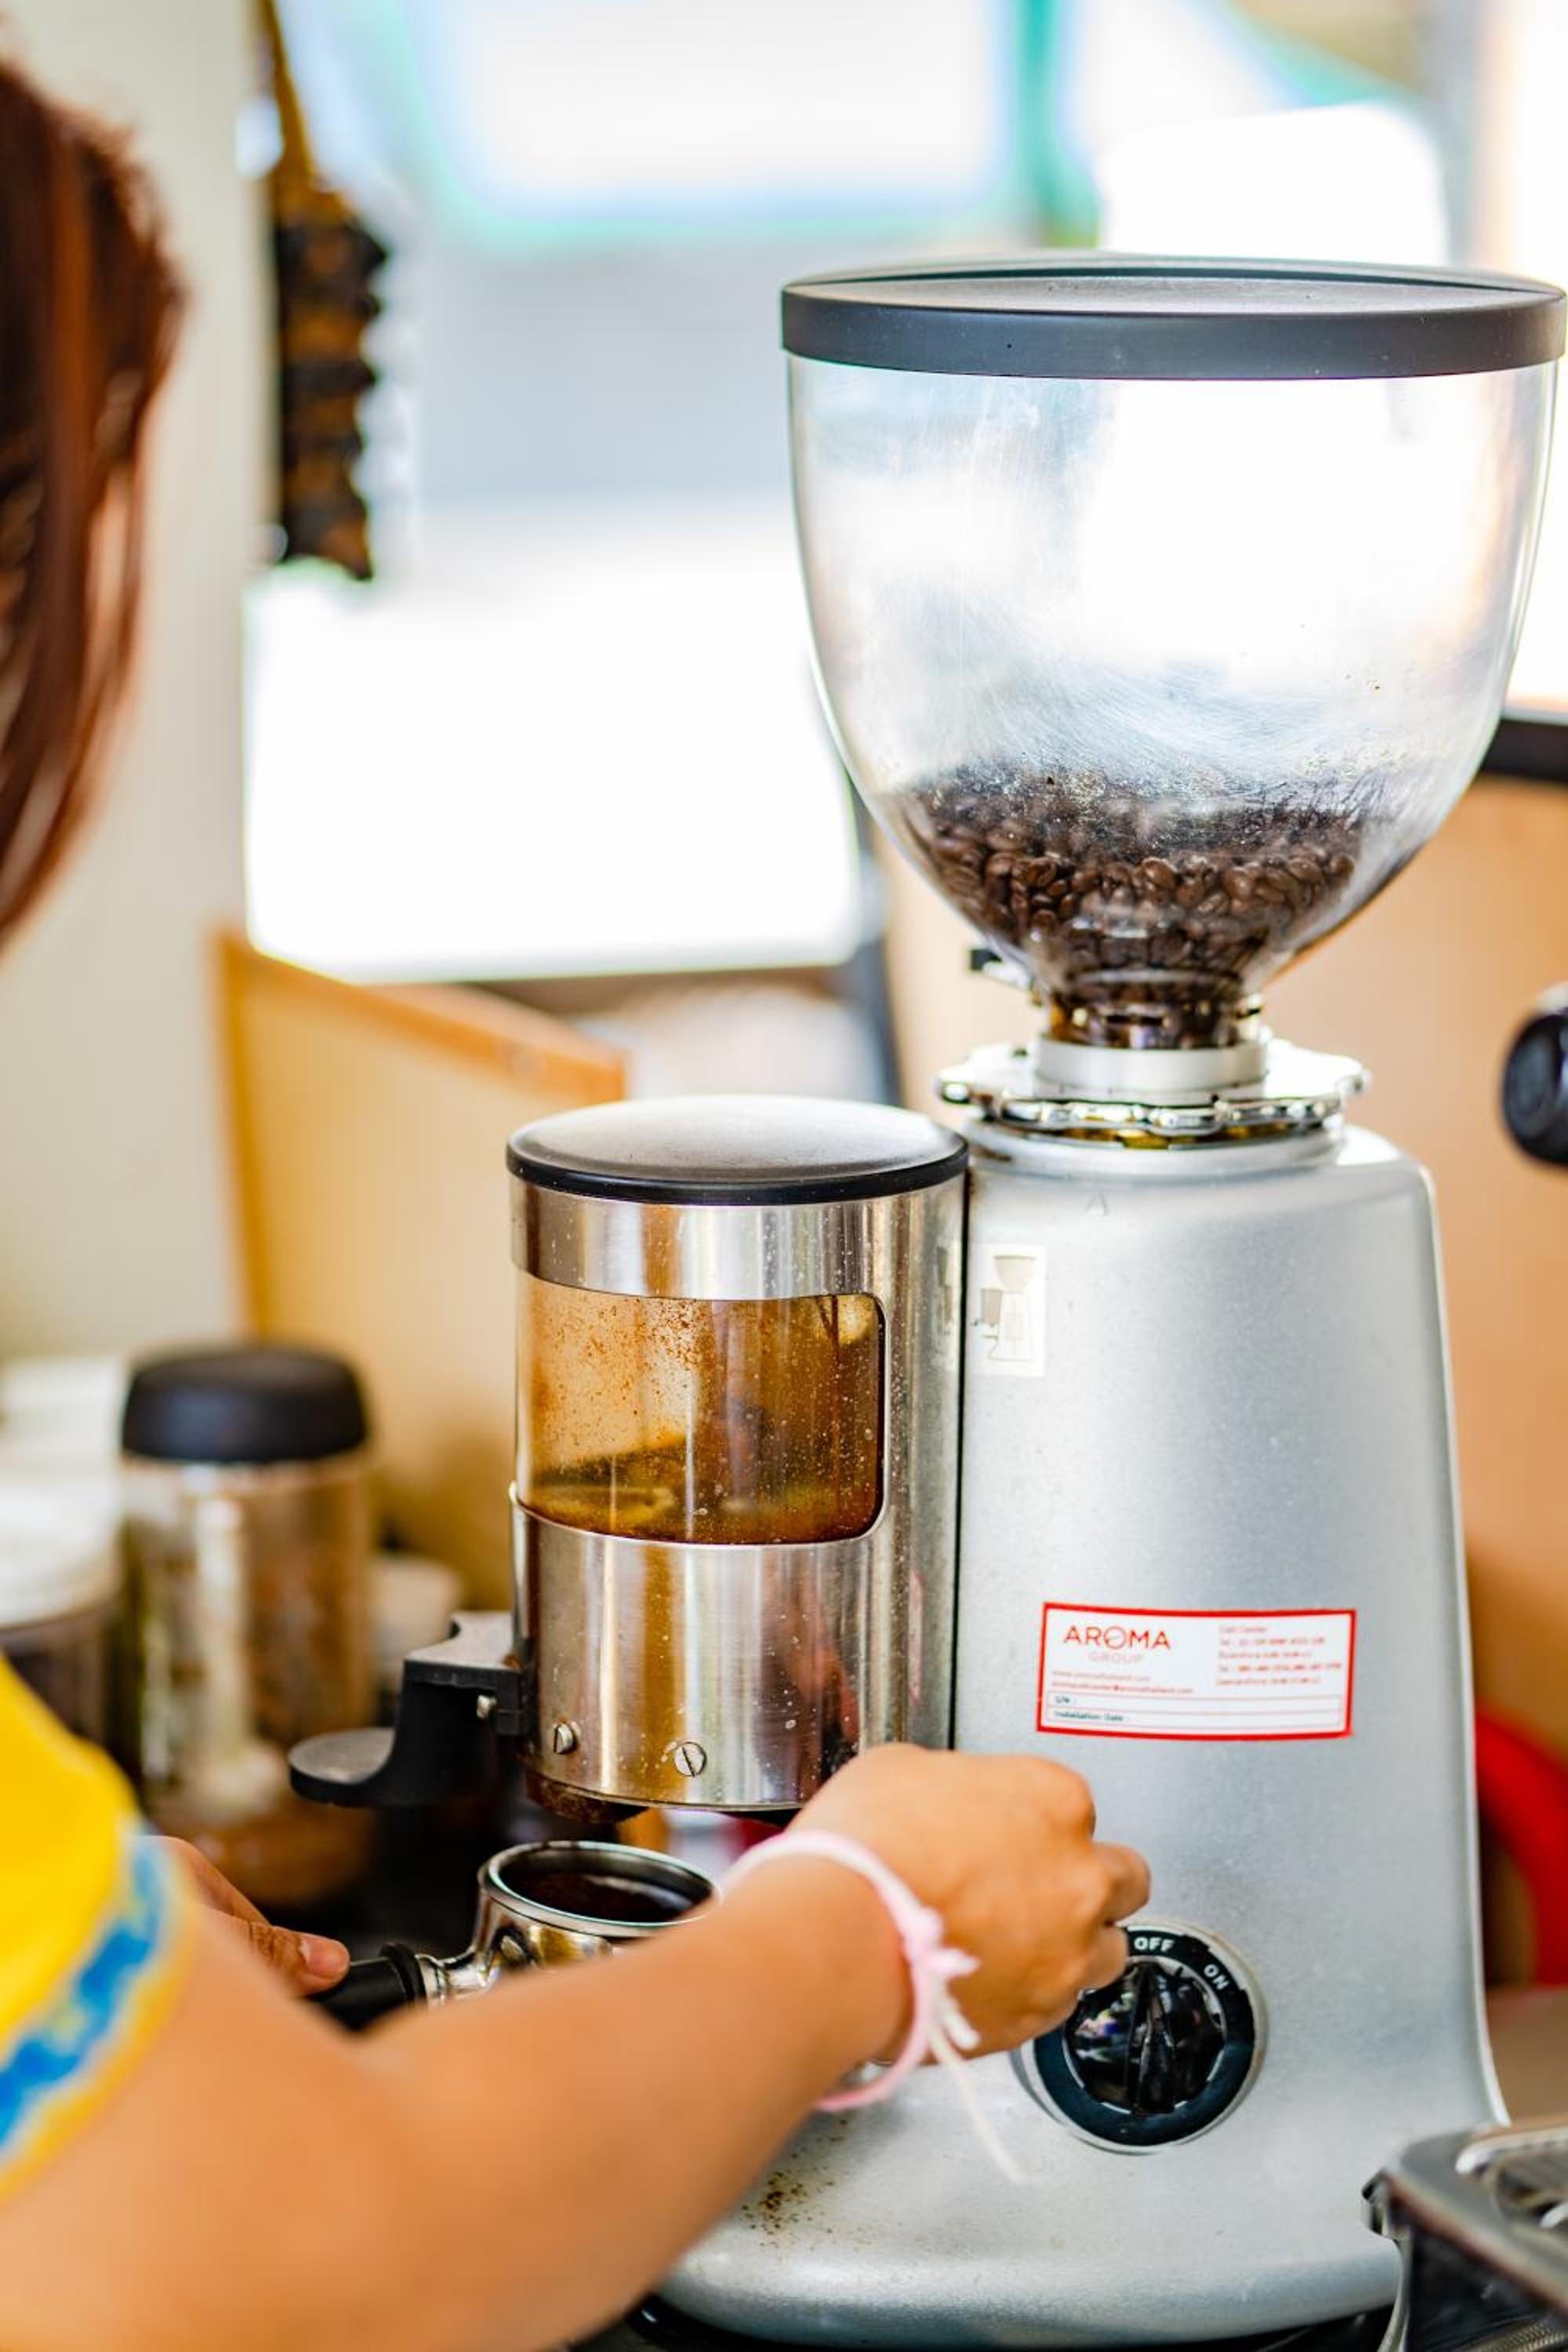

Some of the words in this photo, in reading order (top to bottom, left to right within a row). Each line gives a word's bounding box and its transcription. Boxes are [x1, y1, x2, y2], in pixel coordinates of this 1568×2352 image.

[1063, 1624, 1171, 1650] AROMA
[1088, 1652, 1144, 1664] GROUP
[1134, 1936, 1174, 1951] OFF
[1203, 1964, 1230, 1990] ON
